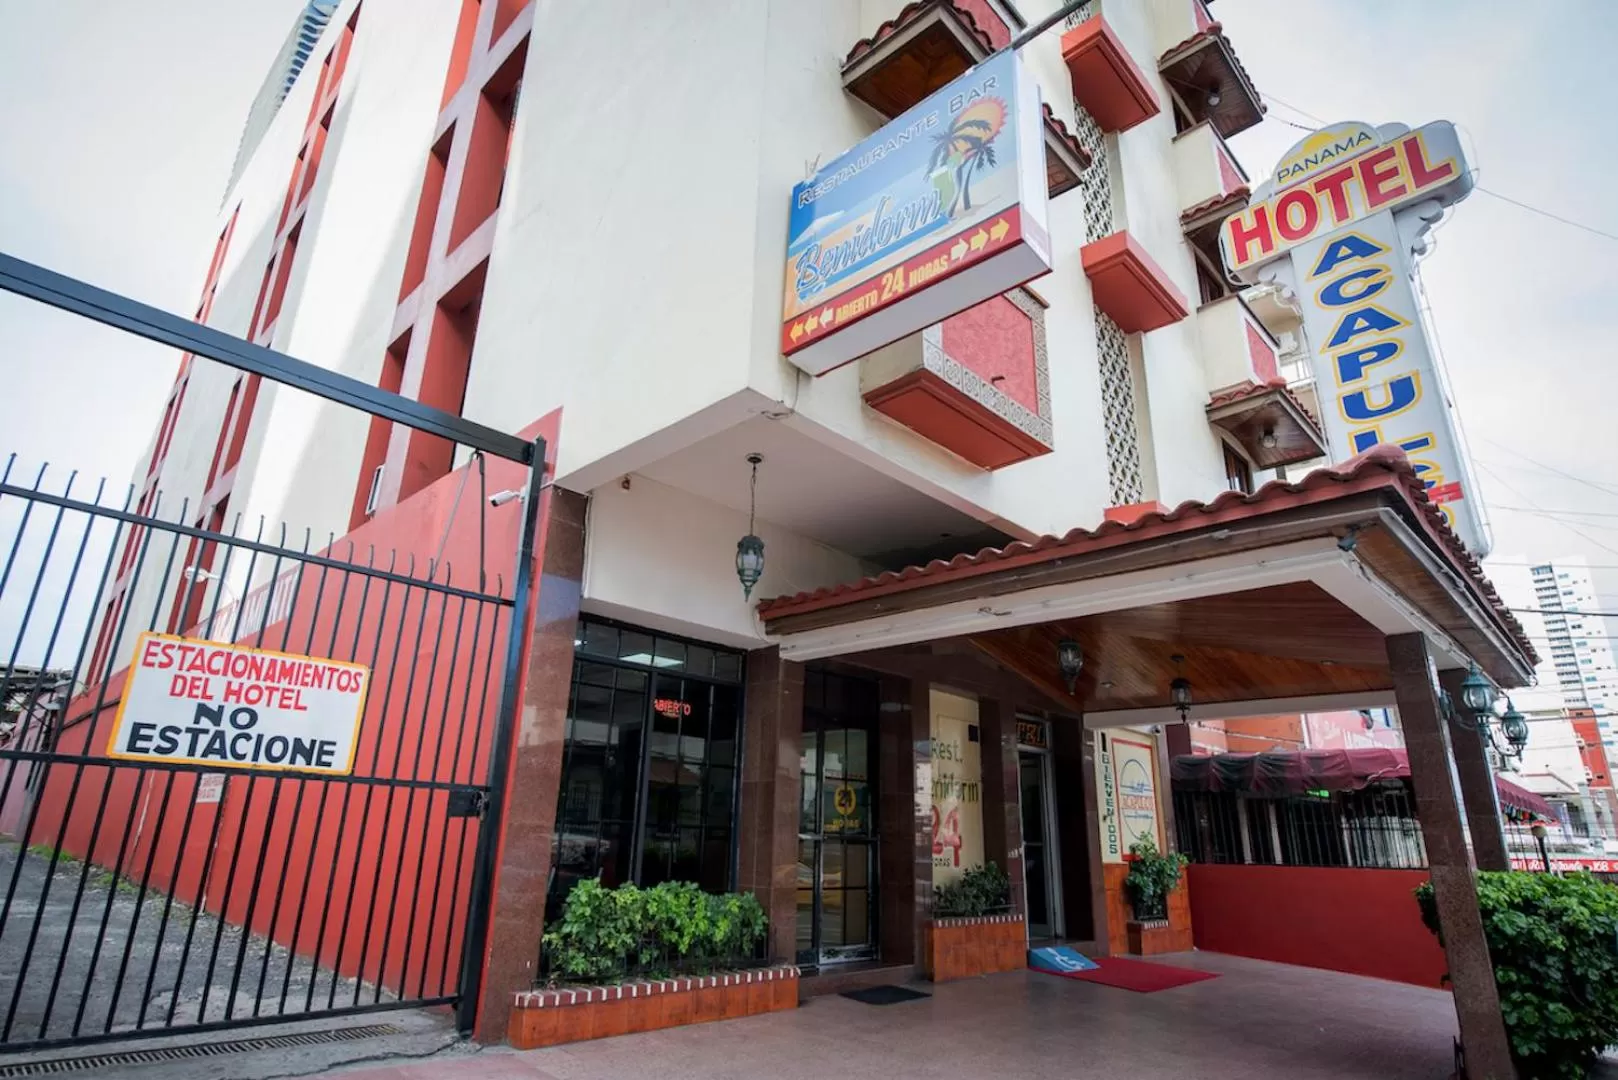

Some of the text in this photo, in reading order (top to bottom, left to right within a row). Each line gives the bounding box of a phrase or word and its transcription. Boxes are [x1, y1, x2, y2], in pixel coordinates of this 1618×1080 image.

[797, 75, 1000, 208] RESTAURANTE BAR
[1276, 130, 1372, 184] PANAMA
[1227, 134, 1455, 266] HOTEL
[796, 189, 945, 292] Benidorm
[834, 253, 949, 325] ABIERTO 24 HORAS
[142, 640, 363, 693] ESTACIONAMIENTOS
[169, 674, 308, 711] DEL HOTEL
[193, 702, 259, 730] NO
[126, 721, 337, 767] ESTACIONE
